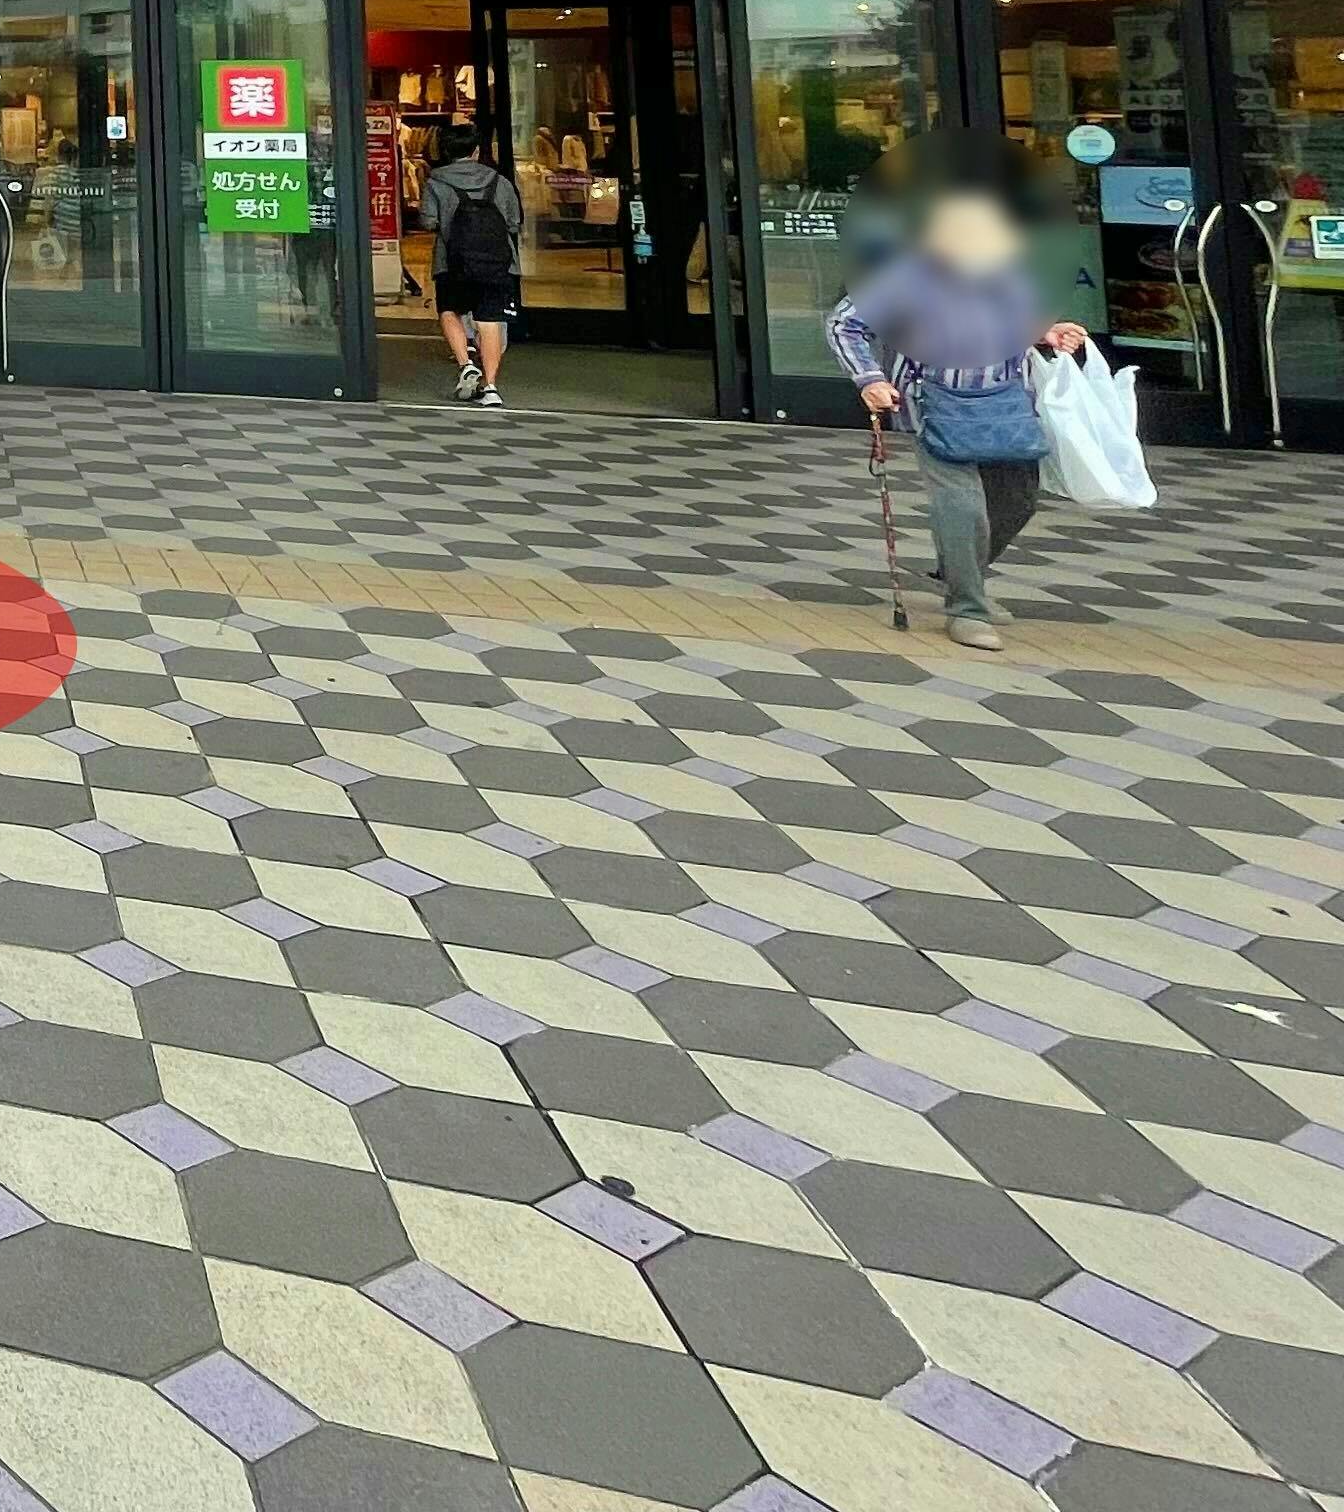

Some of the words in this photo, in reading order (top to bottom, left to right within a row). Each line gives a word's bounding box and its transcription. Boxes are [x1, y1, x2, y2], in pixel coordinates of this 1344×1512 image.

[228, 76, 276, 118] 薬
[213, 138, 298, 153] イオン薬局
[212, 170, 301, 192] 処方せん
[235, 198, 280, 220] 受付
